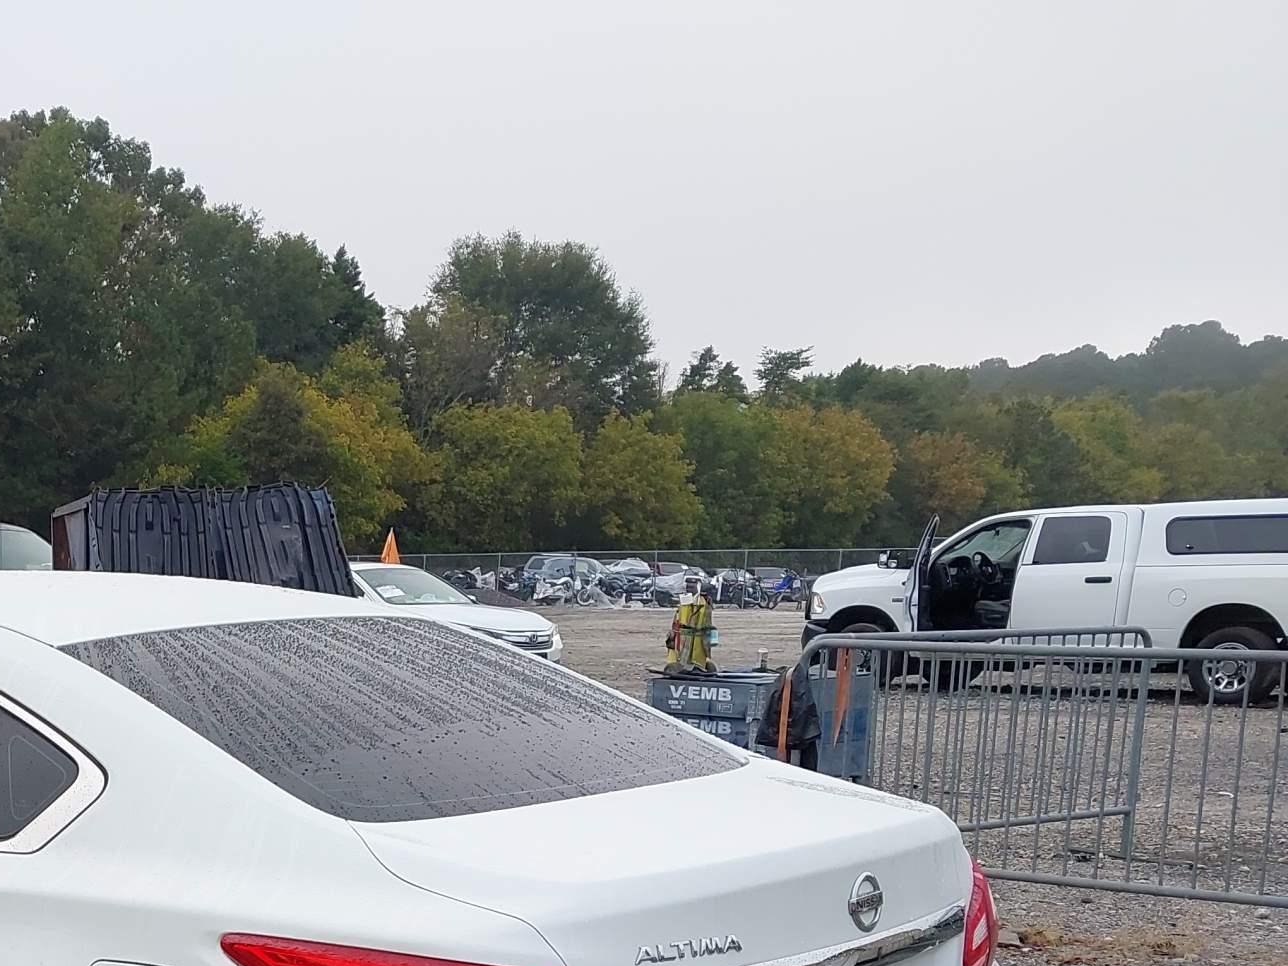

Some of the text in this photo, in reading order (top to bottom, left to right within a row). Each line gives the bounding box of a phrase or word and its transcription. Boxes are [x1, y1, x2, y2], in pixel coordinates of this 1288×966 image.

[669, 684, 732, 701] V-EMB
[686, 718, 732, 735] EMB
[634, 934, 743, 966] ALTIMA
